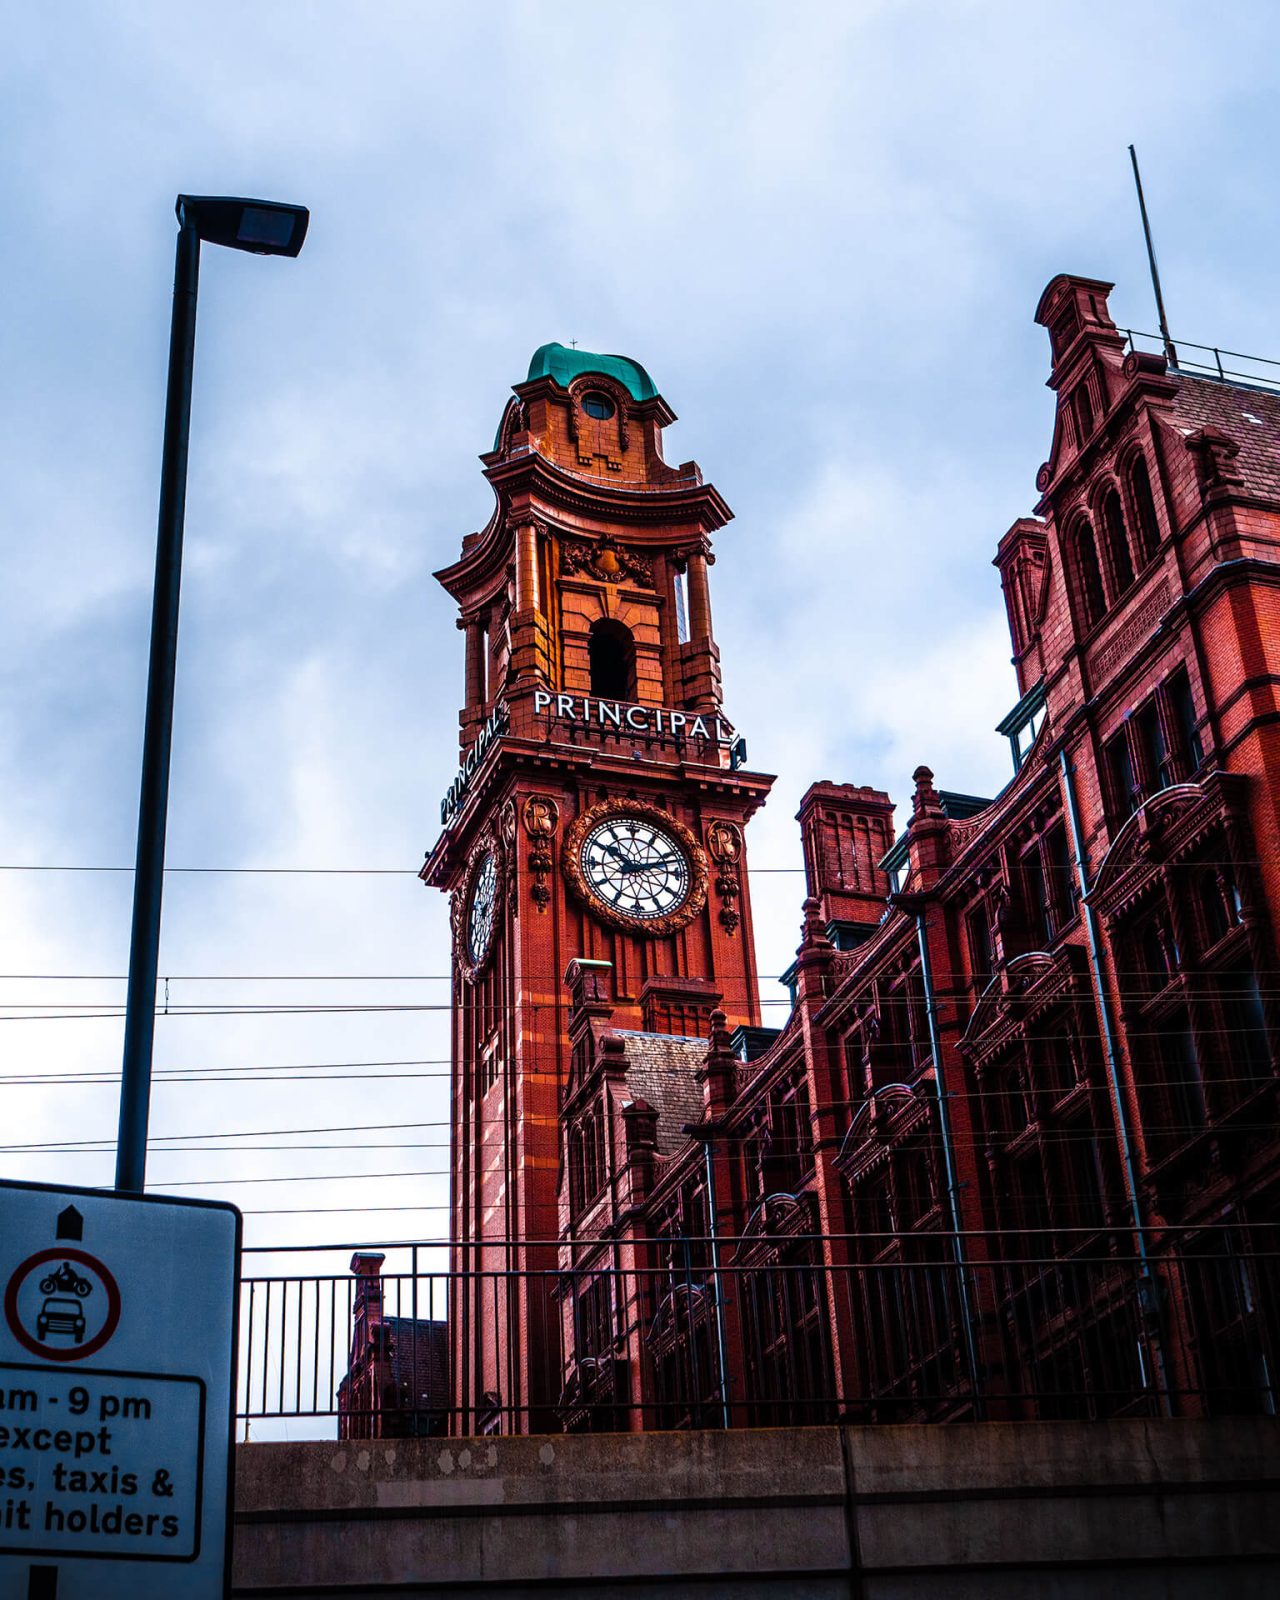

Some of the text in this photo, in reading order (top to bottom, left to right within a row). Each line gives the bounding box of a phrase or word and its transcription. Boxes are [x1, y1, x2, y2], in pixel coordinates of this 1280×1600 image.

[533, 690, 733, 743] PRINCIPAL
[440, 706, 500, 825] PRINCIPAL
[0, 1387, 37, 1411] m
[68, 1386, 90, 1415] 9
[100, 1394, 151, 1421] pm
[0, 1425, 112, 1458] except
[53, 1462, 138, 1495] taxis
[152, 1468, 174, 1497] &
[0, 1499, 179, 1537] it holders
